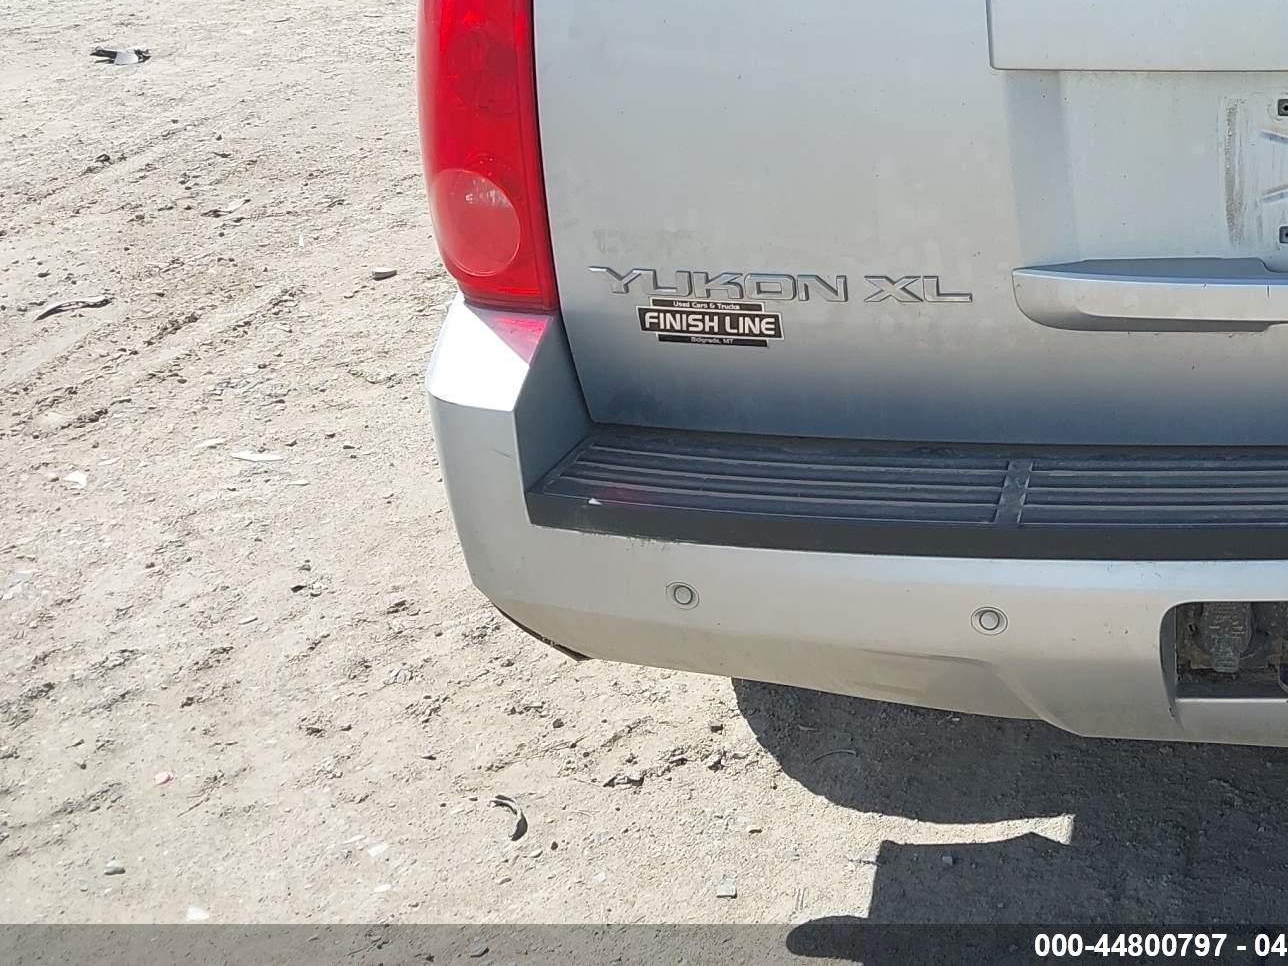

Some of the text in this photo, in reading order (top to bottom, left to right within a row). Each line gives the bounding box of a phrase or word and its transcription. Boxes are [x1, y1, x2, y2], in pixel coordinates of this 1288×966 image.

[588, 266, 973, 303] YUKON XL
[673, 300, 690, 308] Used
[644, 312, 775, 335] FINISH LINE
